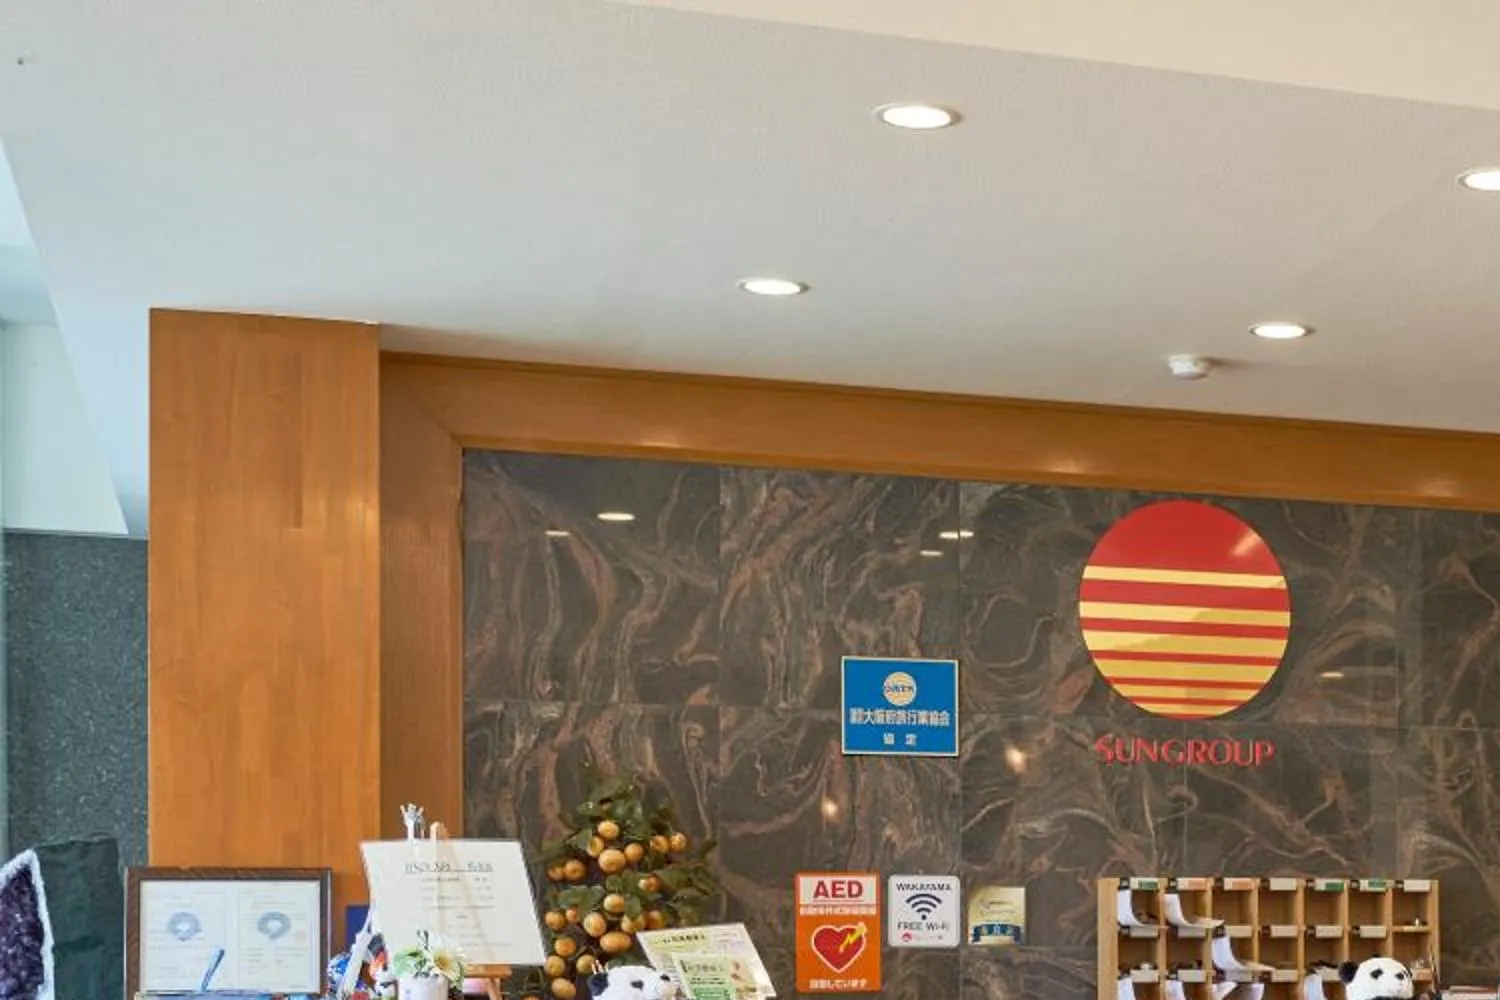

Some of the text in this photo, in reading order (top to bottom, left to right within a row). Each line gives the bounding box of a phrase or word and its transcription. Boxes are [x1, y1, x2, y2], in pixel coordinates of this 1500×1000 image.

[813, 880, 864, 899] AED
[896, 883, 952, 892] WAKAYAMA
[897, 921, 923, 931] FREE
